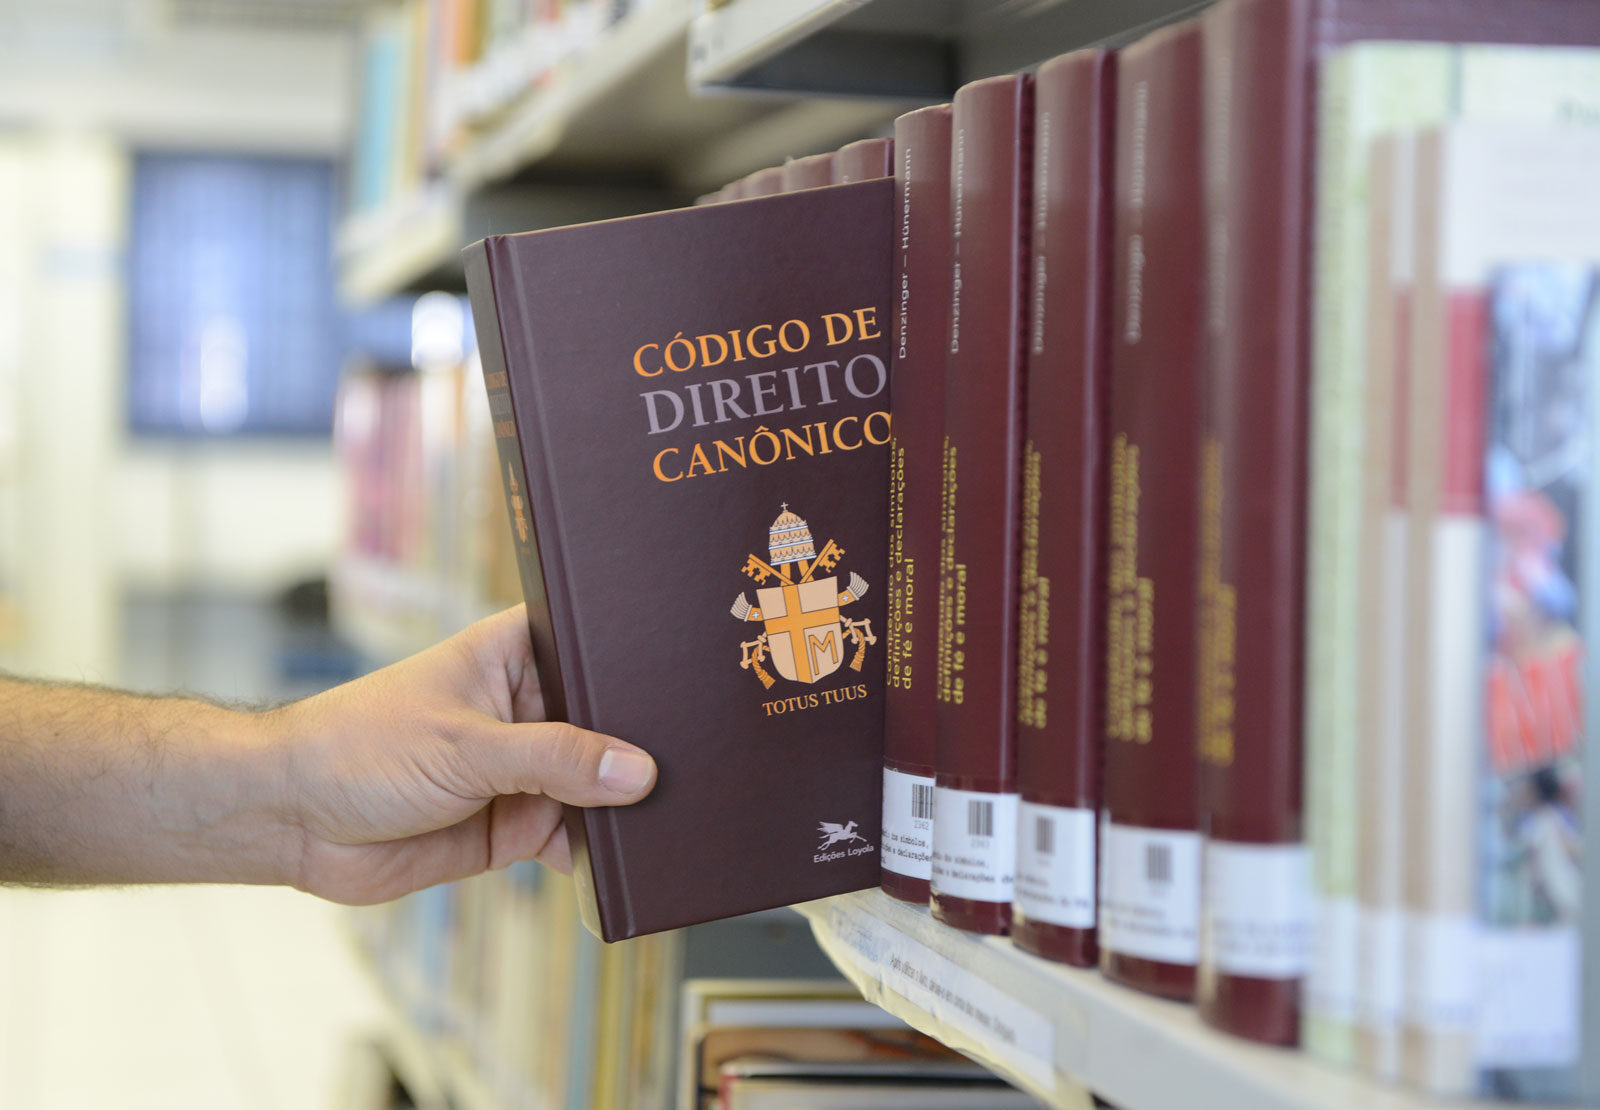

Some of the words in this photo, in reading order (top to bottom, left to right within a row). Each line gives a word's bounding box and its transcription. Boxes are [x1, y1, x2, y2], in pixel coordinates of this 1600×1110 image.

[901, 147, 912, 249] Hünermann
[632, 319, 812, 378] CÓDIGO
[820, 307, 882, 347] DE
[898, 273, 910, 359] Denzinger
[639, 353, 888, 436] DIREITO
[652, 410, 891, 483] CANÔNICO
[895, 447, 906, 564] declarações
[904, 558, 914, 615] moral
[955, 564, 967, 624] moral
[892, 588, 903, 688] definições
[902, 640, 912, 659] fé
[905, 622, 913, 633] e
[955, 631, 965, 645] e
[902, 666, 912, 690] de
[953, 650, 965, 671] fé
[762, 693, 819, 717] TOTUS
[821, 684, 868, 705] TUUS
[953, 677, 964, 704] de
[813, 851, 846, 864] Edições
[847, 844, 875, 857] Loyola
